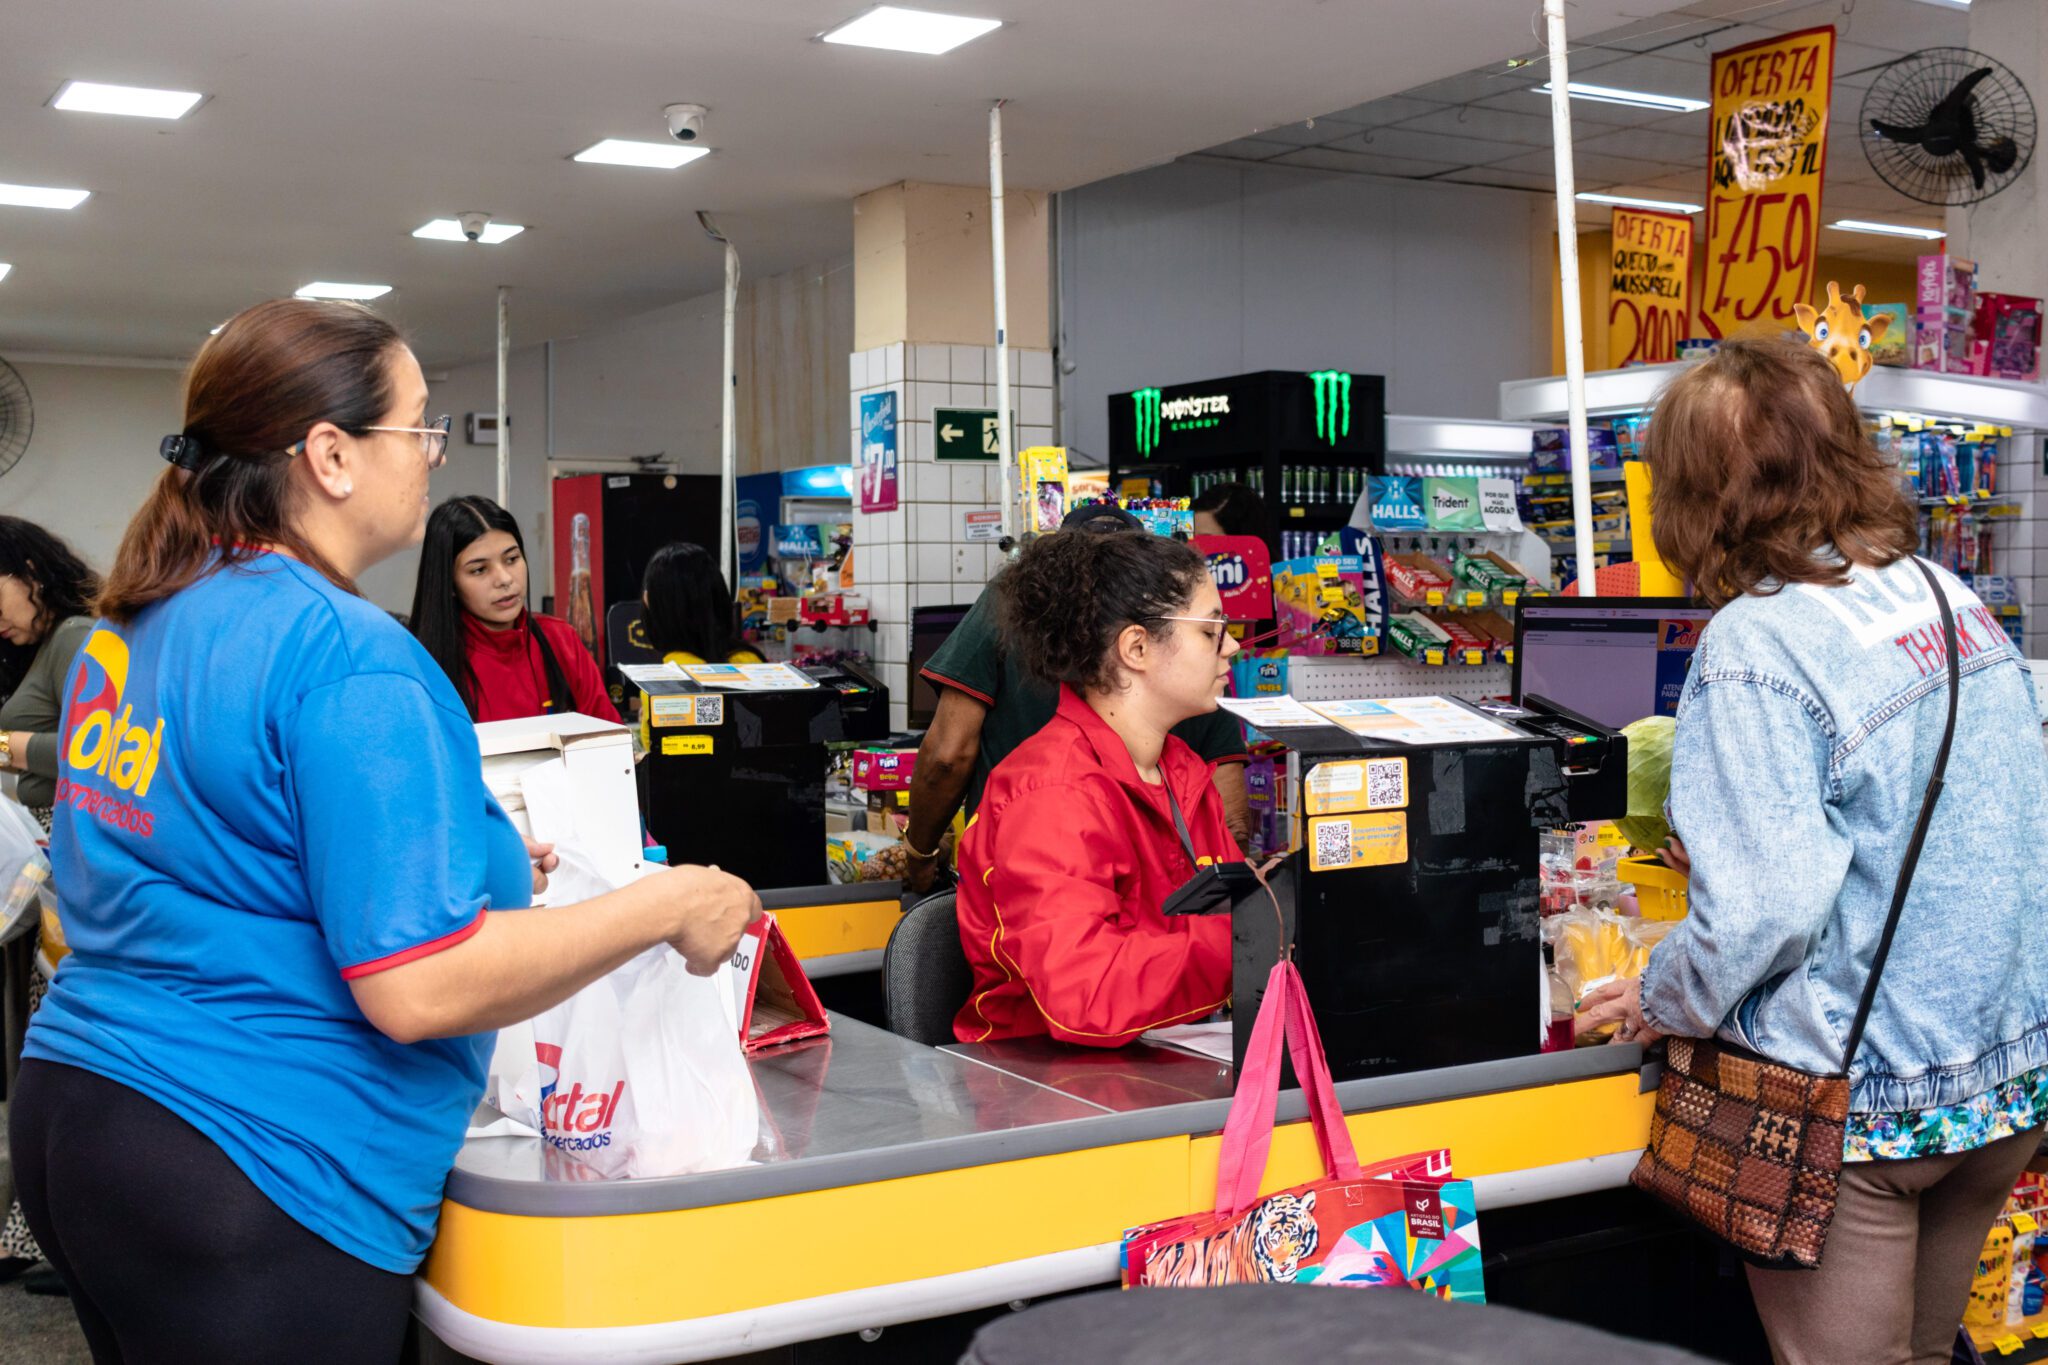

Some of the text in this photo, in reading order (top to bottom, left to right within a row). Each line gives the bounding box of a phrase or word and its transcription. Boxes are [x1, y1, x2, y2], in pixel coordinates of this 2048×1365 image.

[1720, 46, 1820, 98] OFERTA
[1616, 214, 1685, 258] OFERTA
[1160, 395, 1230, 420] MONSTER
[1171, 418, 1220, 431] ENERGY
[1432, 496, 1469, 508] Trident
[1484, 507, 1515, 515] AGORA?
[1206, 555, 1243, 585] ini
[1391, 566, 1416, 590] HALLS
[1466, 565, 1490, 588] HALLS
[1389, 626, 1414, 650] HALLS
[1260, 664, 1278, 677] Fini
[61, 629, 165, 798] Portal
[879, 756, 899, 767] Fini
[1250, 775, 1265, 786] Fini
[1410, 1217, 1441, 1228] BRASIL
